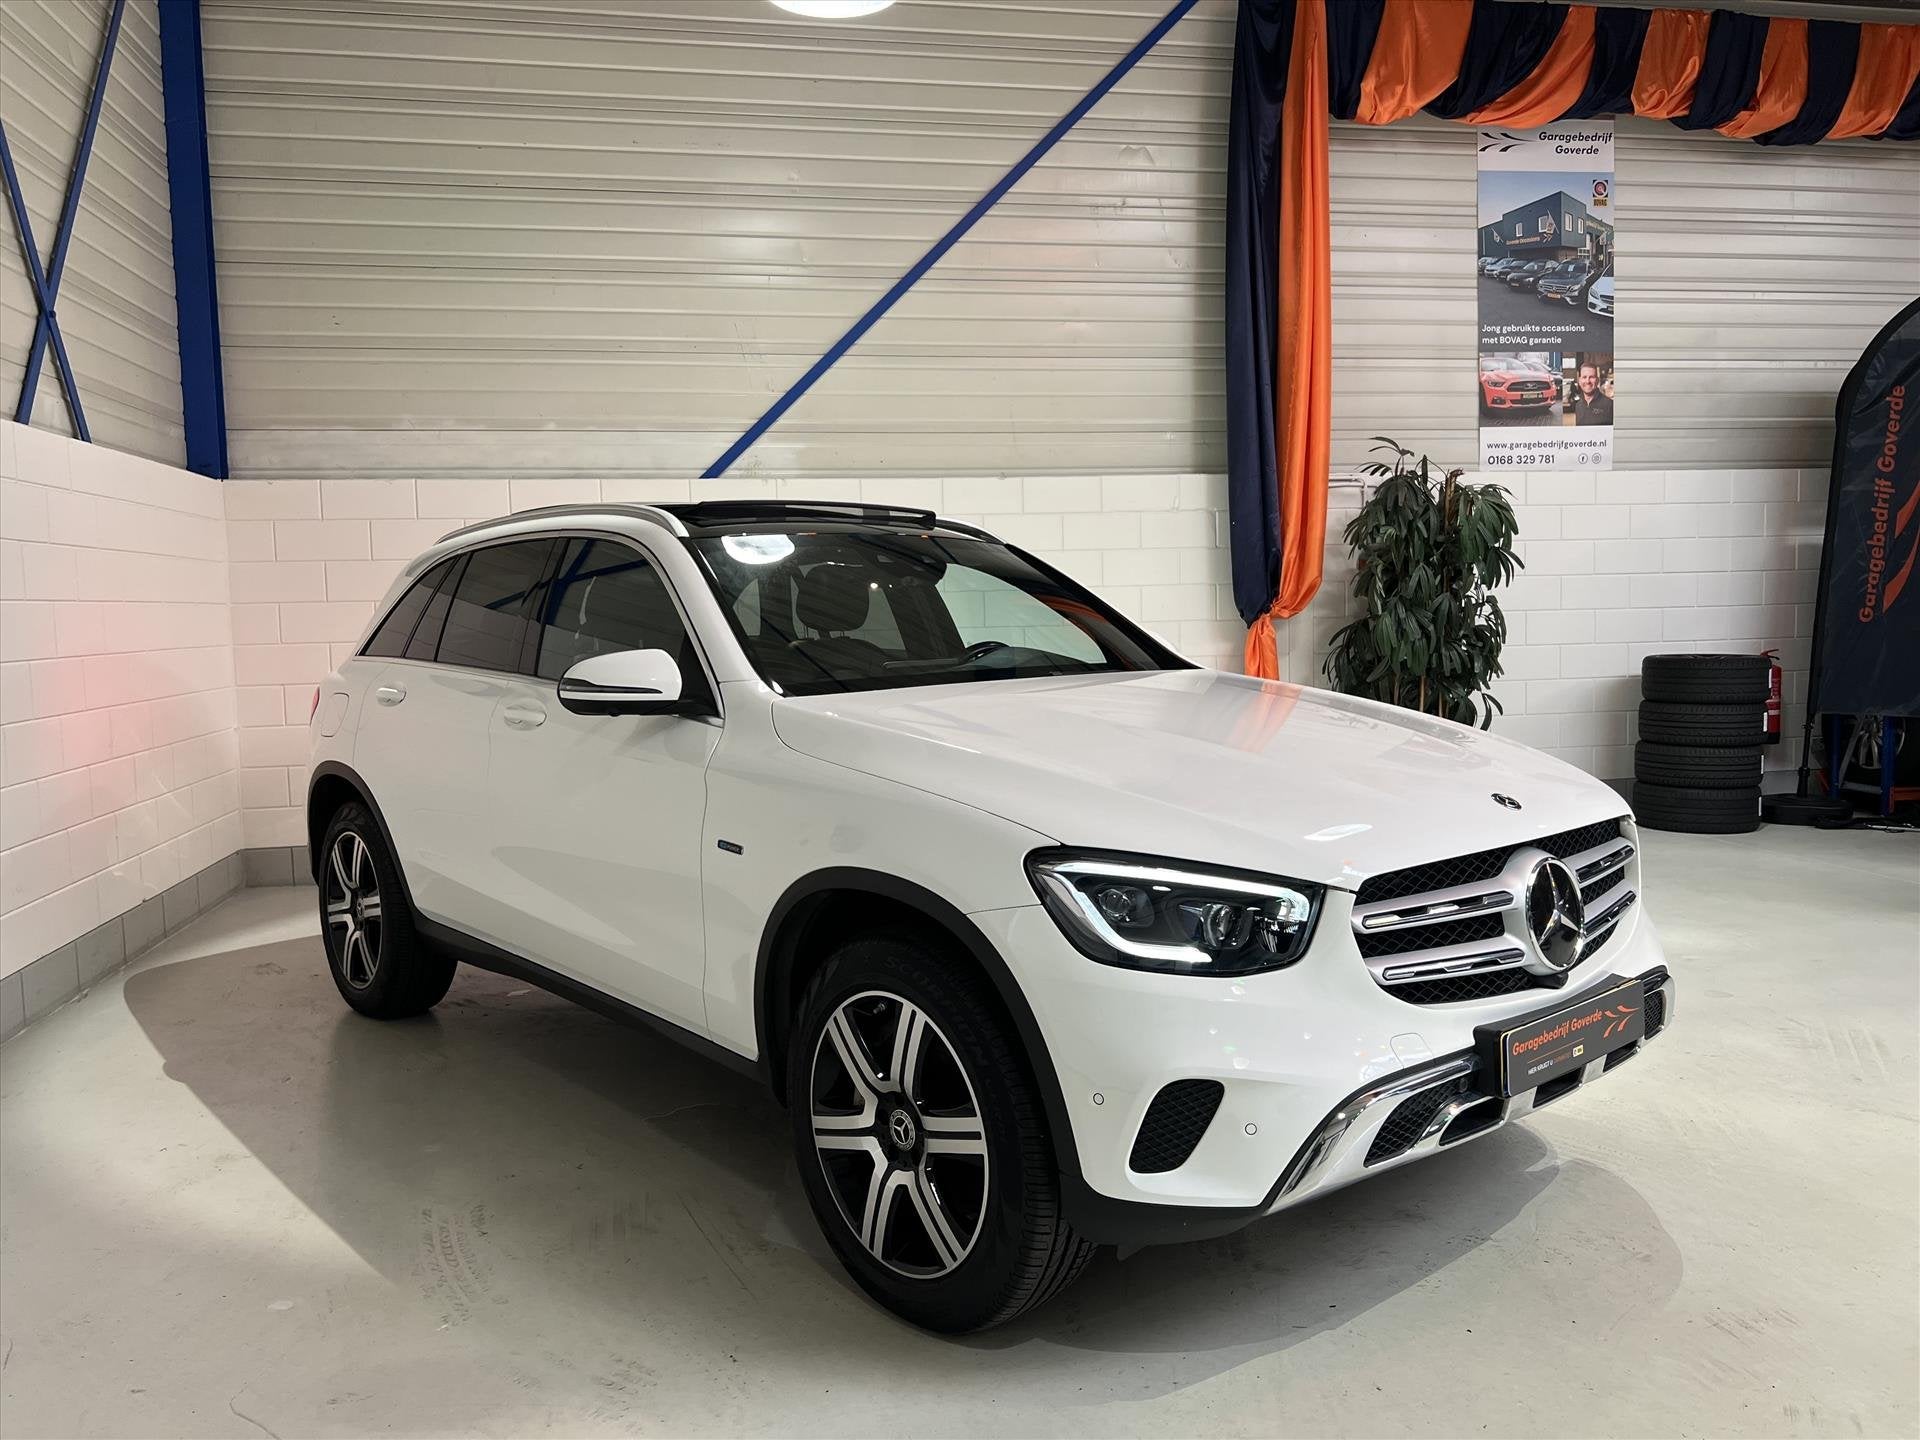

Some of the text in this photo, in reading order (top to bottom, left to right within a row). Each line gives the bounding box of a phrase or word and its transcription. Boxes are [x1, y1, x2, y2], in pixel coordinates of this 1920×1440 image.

[1538, 131, 1613, 144] Garagebedrijf
[1555, 145, 1599, 155] Goverde
[1482, 324, 1585, 333] Jong gebruikte occassions
[1500, 336, 1528, 344] BOVAG
[1529, 336, 1562, 346] garantie
[1487, 440, 1607, 449] www.garagebedrijfgoverde.nl
[1488, 455, 1555, 465] 0168 329 781
[1859, 385, 1905, 623] Garagebedrijf Goverde
[1512, 1020, 1570, 1056] Garagebedrijf
[1571, 1009, 1603, 1031] Goverde
